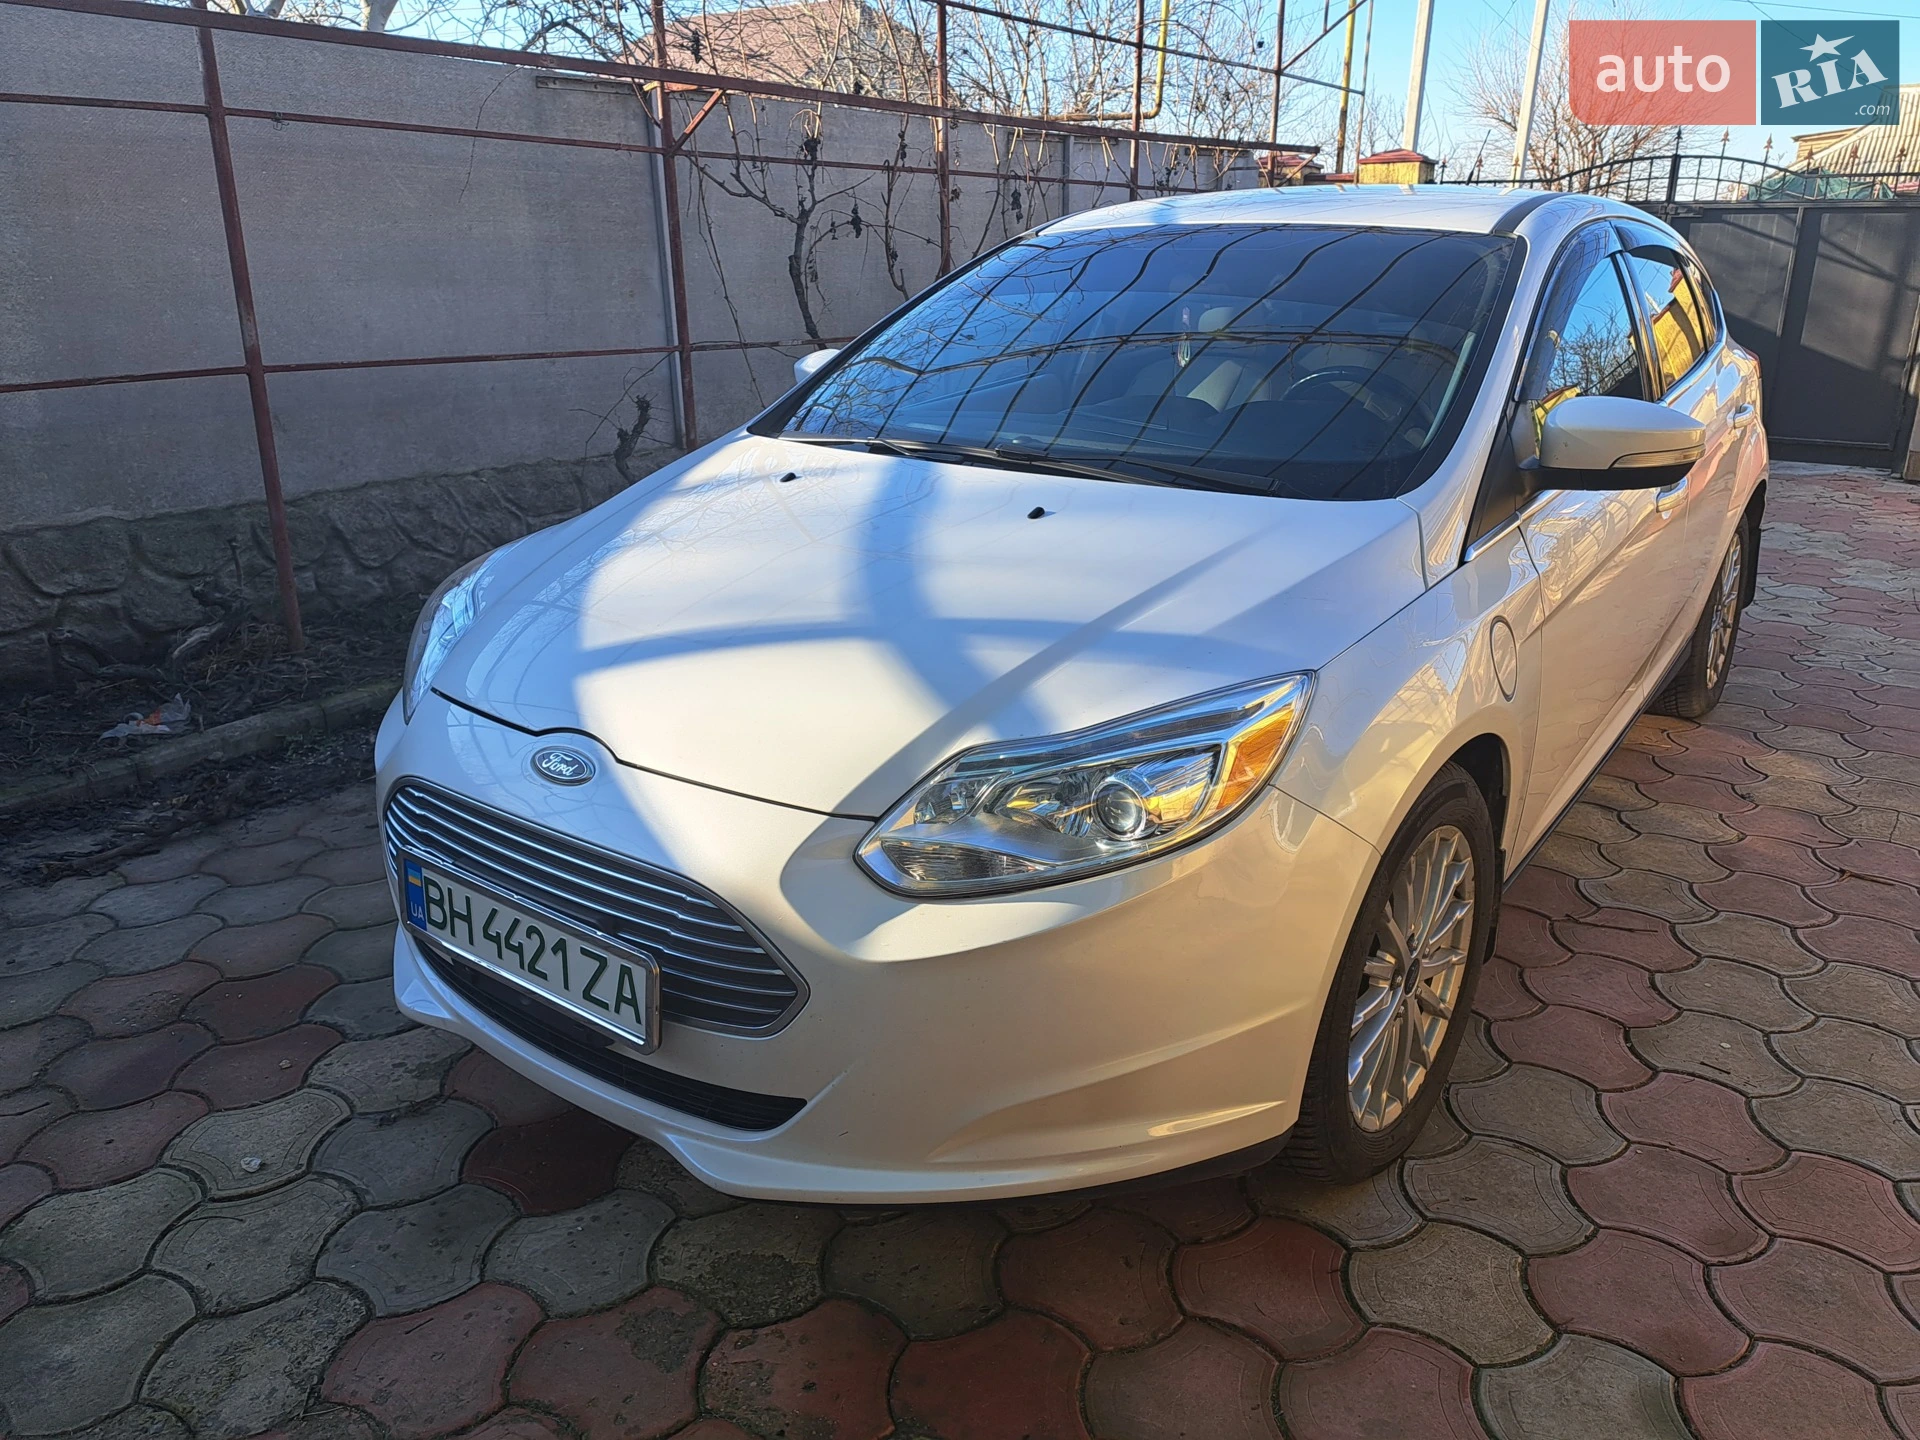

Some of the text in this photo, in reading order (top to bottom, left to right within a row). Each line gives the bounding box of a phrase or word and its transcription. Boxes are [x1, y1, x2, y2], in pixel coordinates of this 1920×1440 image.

[541, 752, 579, 776] Ford
[410, 901, 425, 922] UA
[424, 875, 642, 1025] BH 4421 ZA
